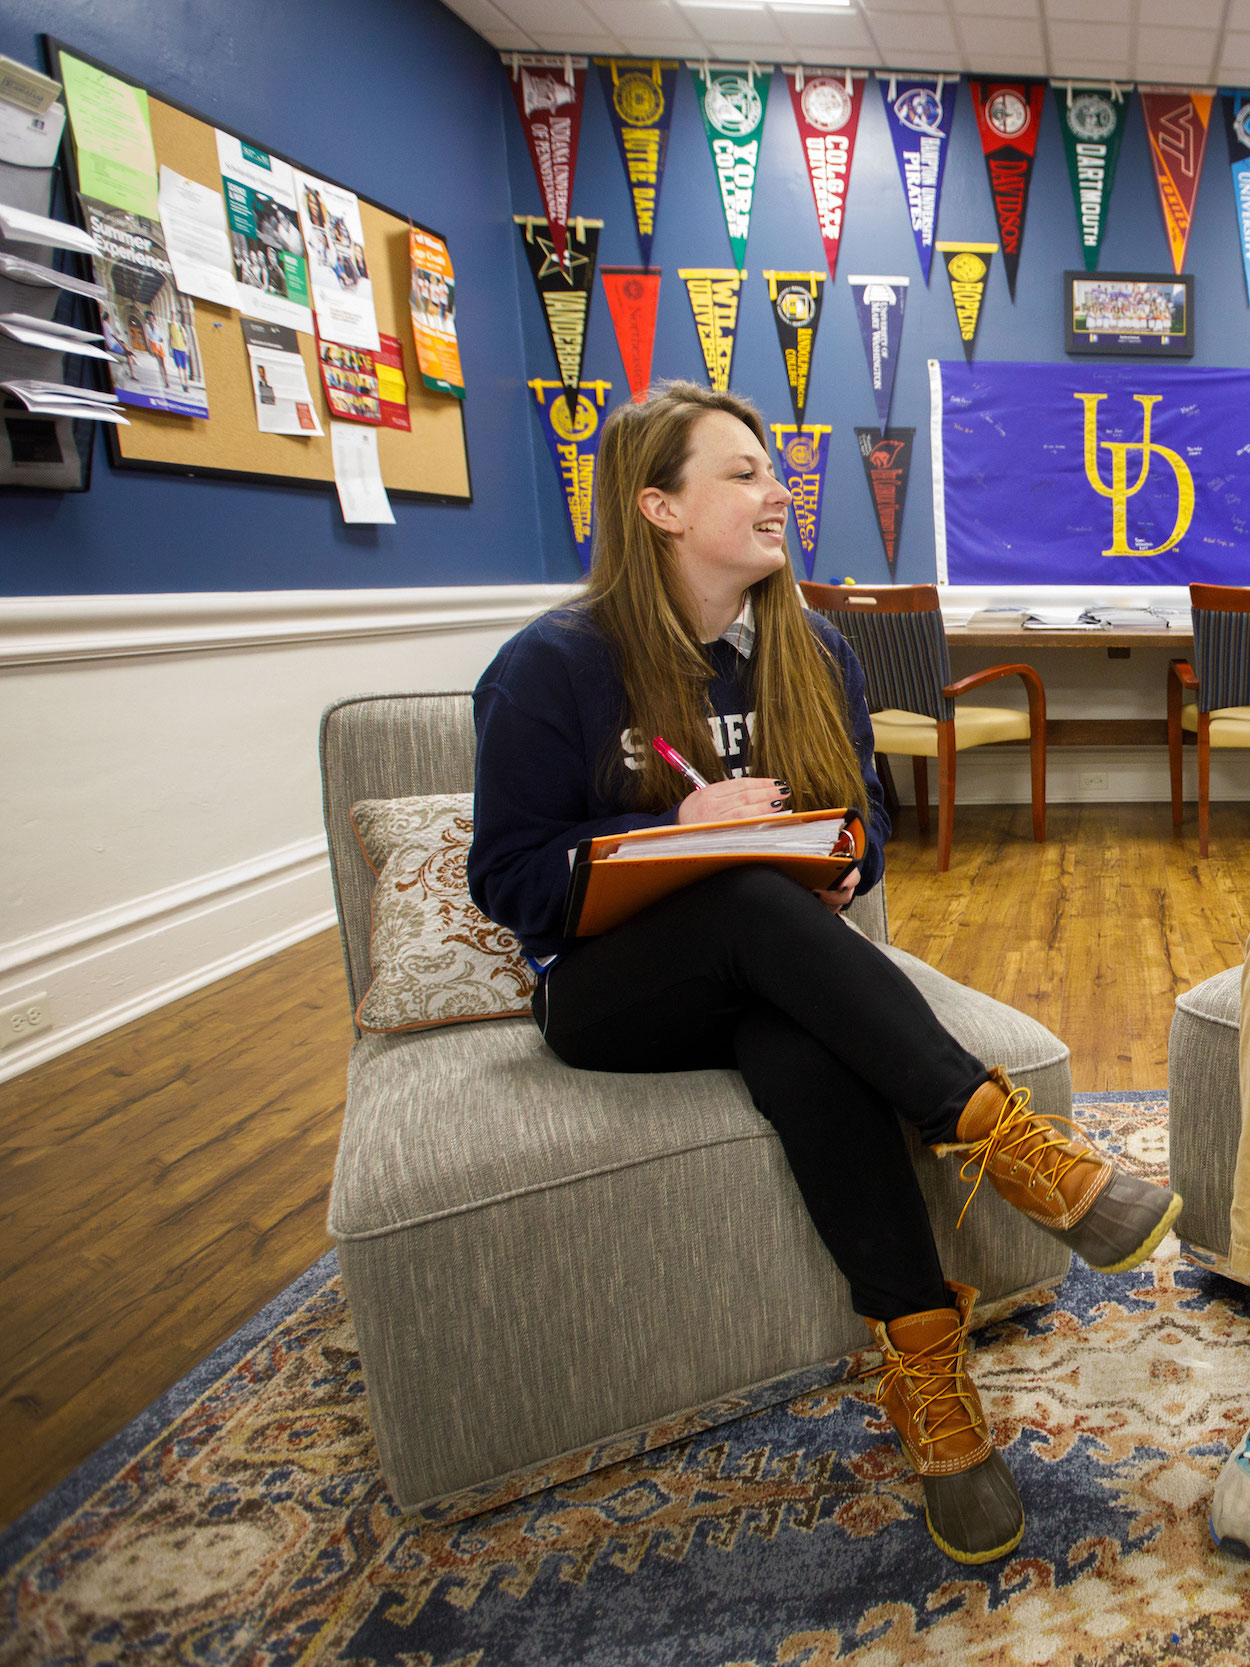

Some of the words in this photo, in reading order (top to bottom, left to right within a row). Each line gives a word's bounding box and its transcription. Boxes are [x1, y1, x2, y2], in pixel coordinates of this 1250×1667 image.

[621, 127, 660, 184] NOTRE
[1159, 102, 1194, 179] VT
[632, 188, 656, 236] DAME
[713, 139, 737, 238] COLLEGE
[734, 140, 758, 240] YORK
[806, 137, 829, 238] UNIVERSITY
[825, 135, 849, 240] COLGATE
[903, 150, 922, 232] PIRATES
[989, 159, 1028, 254] DAVIDSON
[1076, 143, 1107, 246] DARTMOUTH
[90, 216, 152, 252] Summer
[92, 231, 173, 274] Experience
[543, 291, 588, 389] VANDERBILT
[711, 278, 740, 392] WILKES
[951, 281, 984, 341] HOPKINS
[785, 349, 797, 387] COLLEGE
[872, 330, 881, 390] WASHINGTON
[788, 476, 808, 549] COLLEGE
[802, 473, 820, 552] ITHACA
